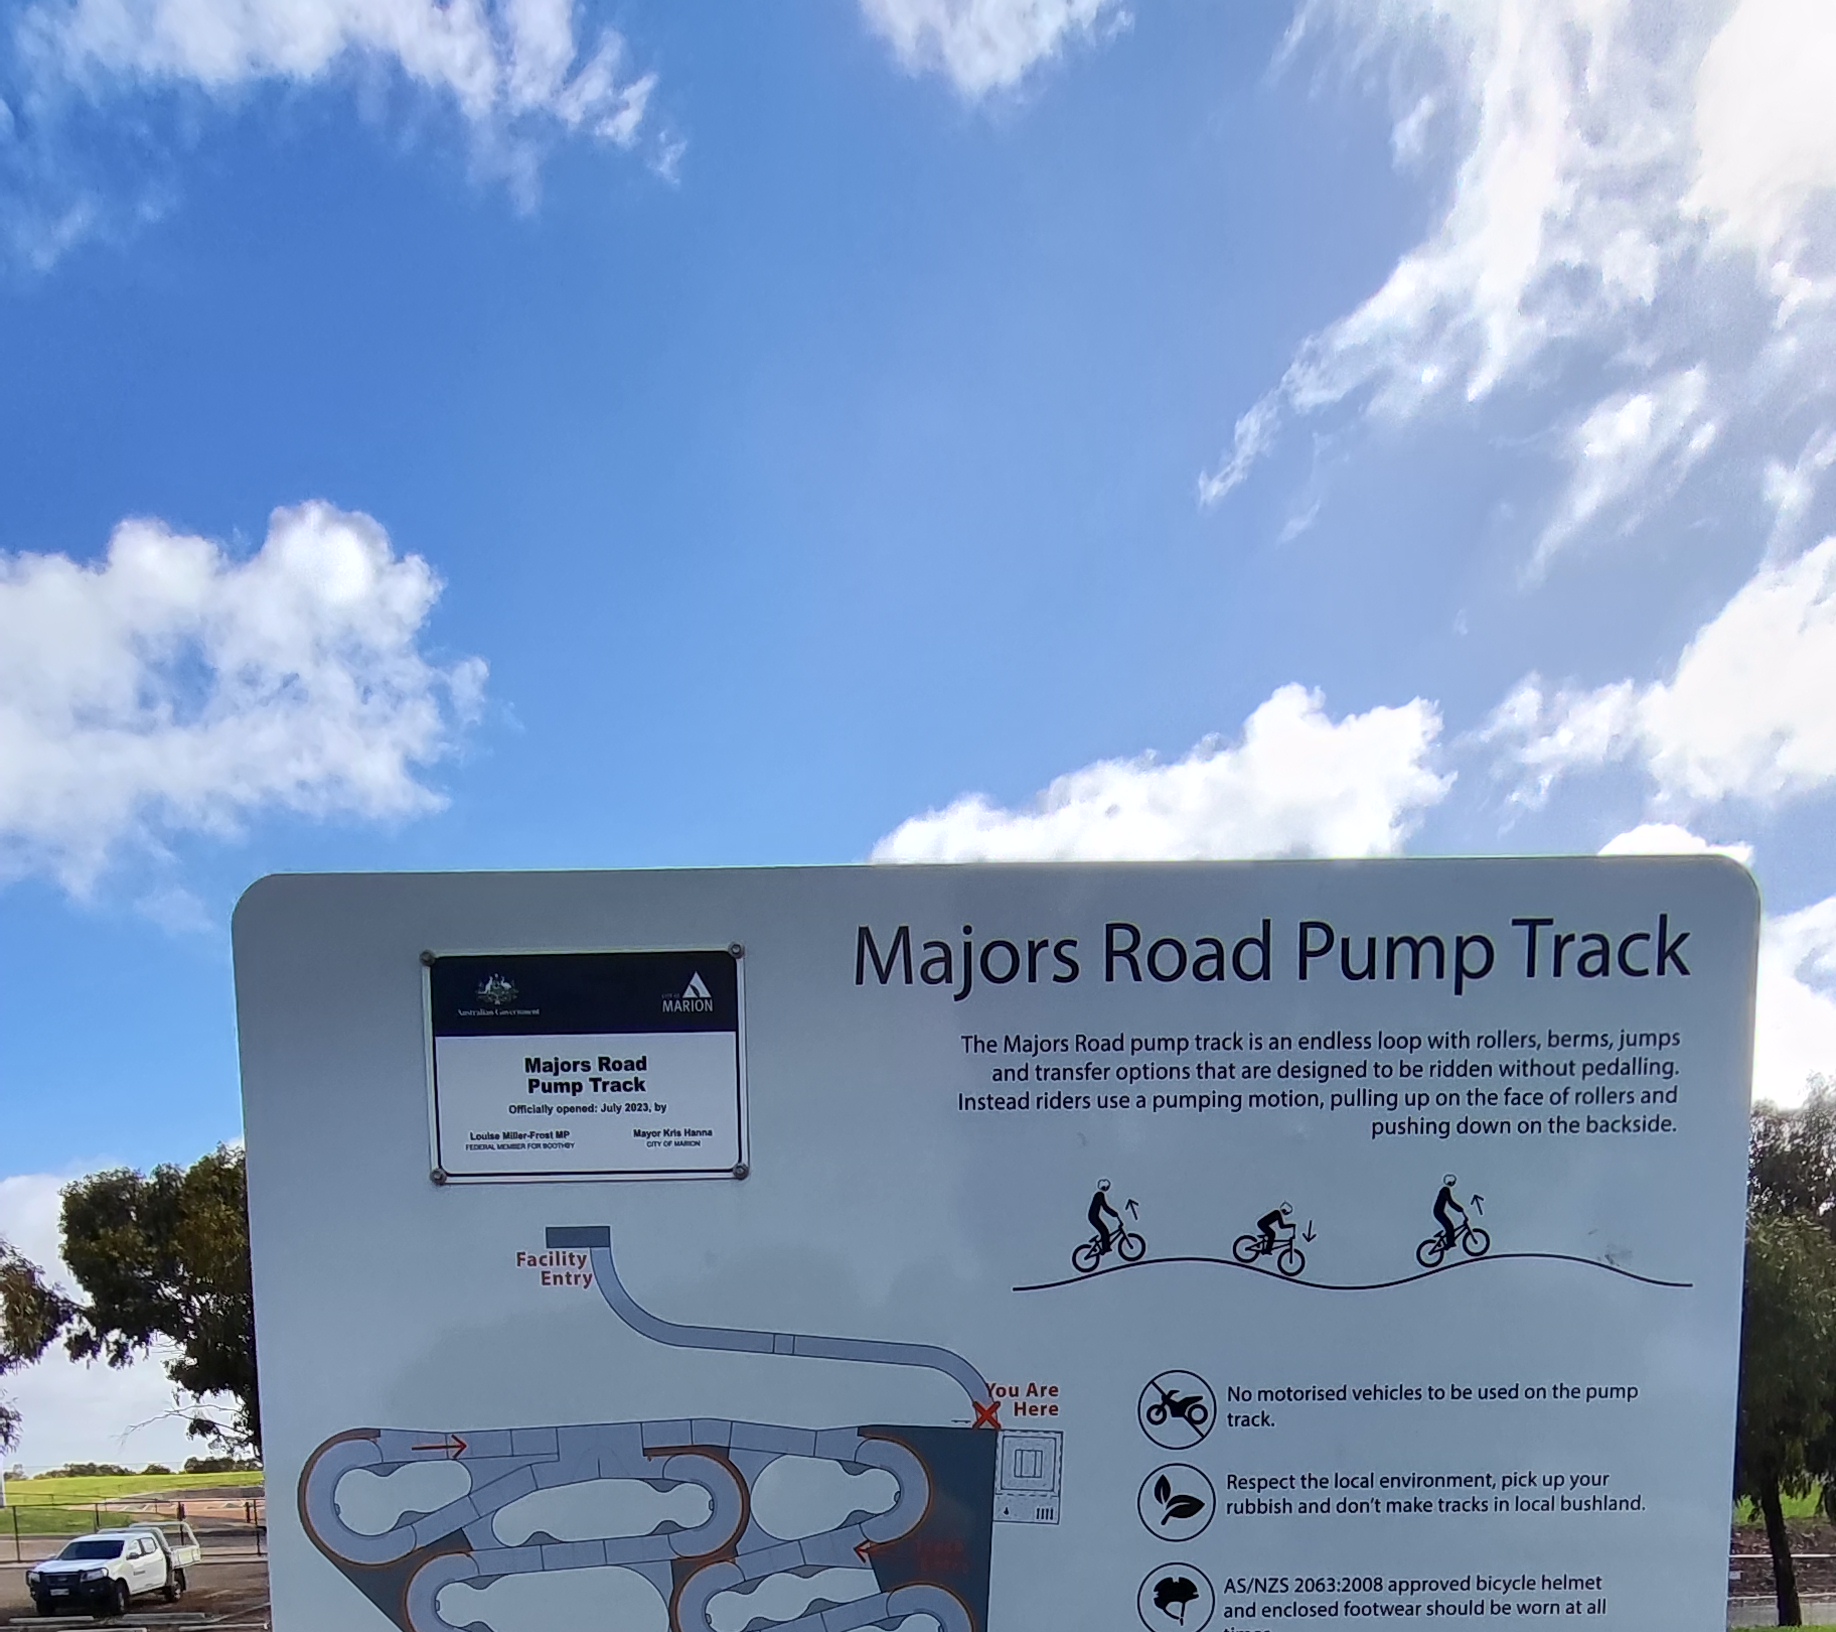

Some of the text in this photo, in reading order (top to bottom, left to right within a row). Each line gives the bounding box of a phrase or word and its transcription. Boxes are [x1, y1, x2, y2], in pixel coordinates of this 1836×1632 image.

[856, 912, 1690, 1001] Majors Road Pump Track
[663, 999, 712, 1012] MARION
[961, 1030, 1680, 1057] The Majors Road pump track is an endless loop with rollers, berms, jumps
[525, 1056, 646, 1076] Majors Road
[992, 1058, 1678, 1084] and transfer options that are designed to be ridden without pedalling.
[528, 1077, 646, 1096] Pump Track
[509, 1101, 666, 1115] Officially opened: July 2023, by
[470, 1130, 570, 1141] Louise Miller-Frost MP
[634, 1128, 712, 1139] Mayor Kris Hanna
[517, 1251, 587, 1269] Facility
[541, 1271, 593, 1289] Entry
[986, 1382, 1058, 1397] You Are
[1228, 1383, 1638, 1402] No motorised vehicles to be used on the pump
[1015, 1401, 1058, 1416] Here
[1228, 1410, 1274, 1426] track.
[1228, 1471, 1609, 1493] Respect the local environment, pick up your
[1224, 1574, 1602, 1595] AS/NZS 2063:2008 approved bicycle helmet
[1224, 1599, 1606, 1618] and enclosed footwear should be worn at all
